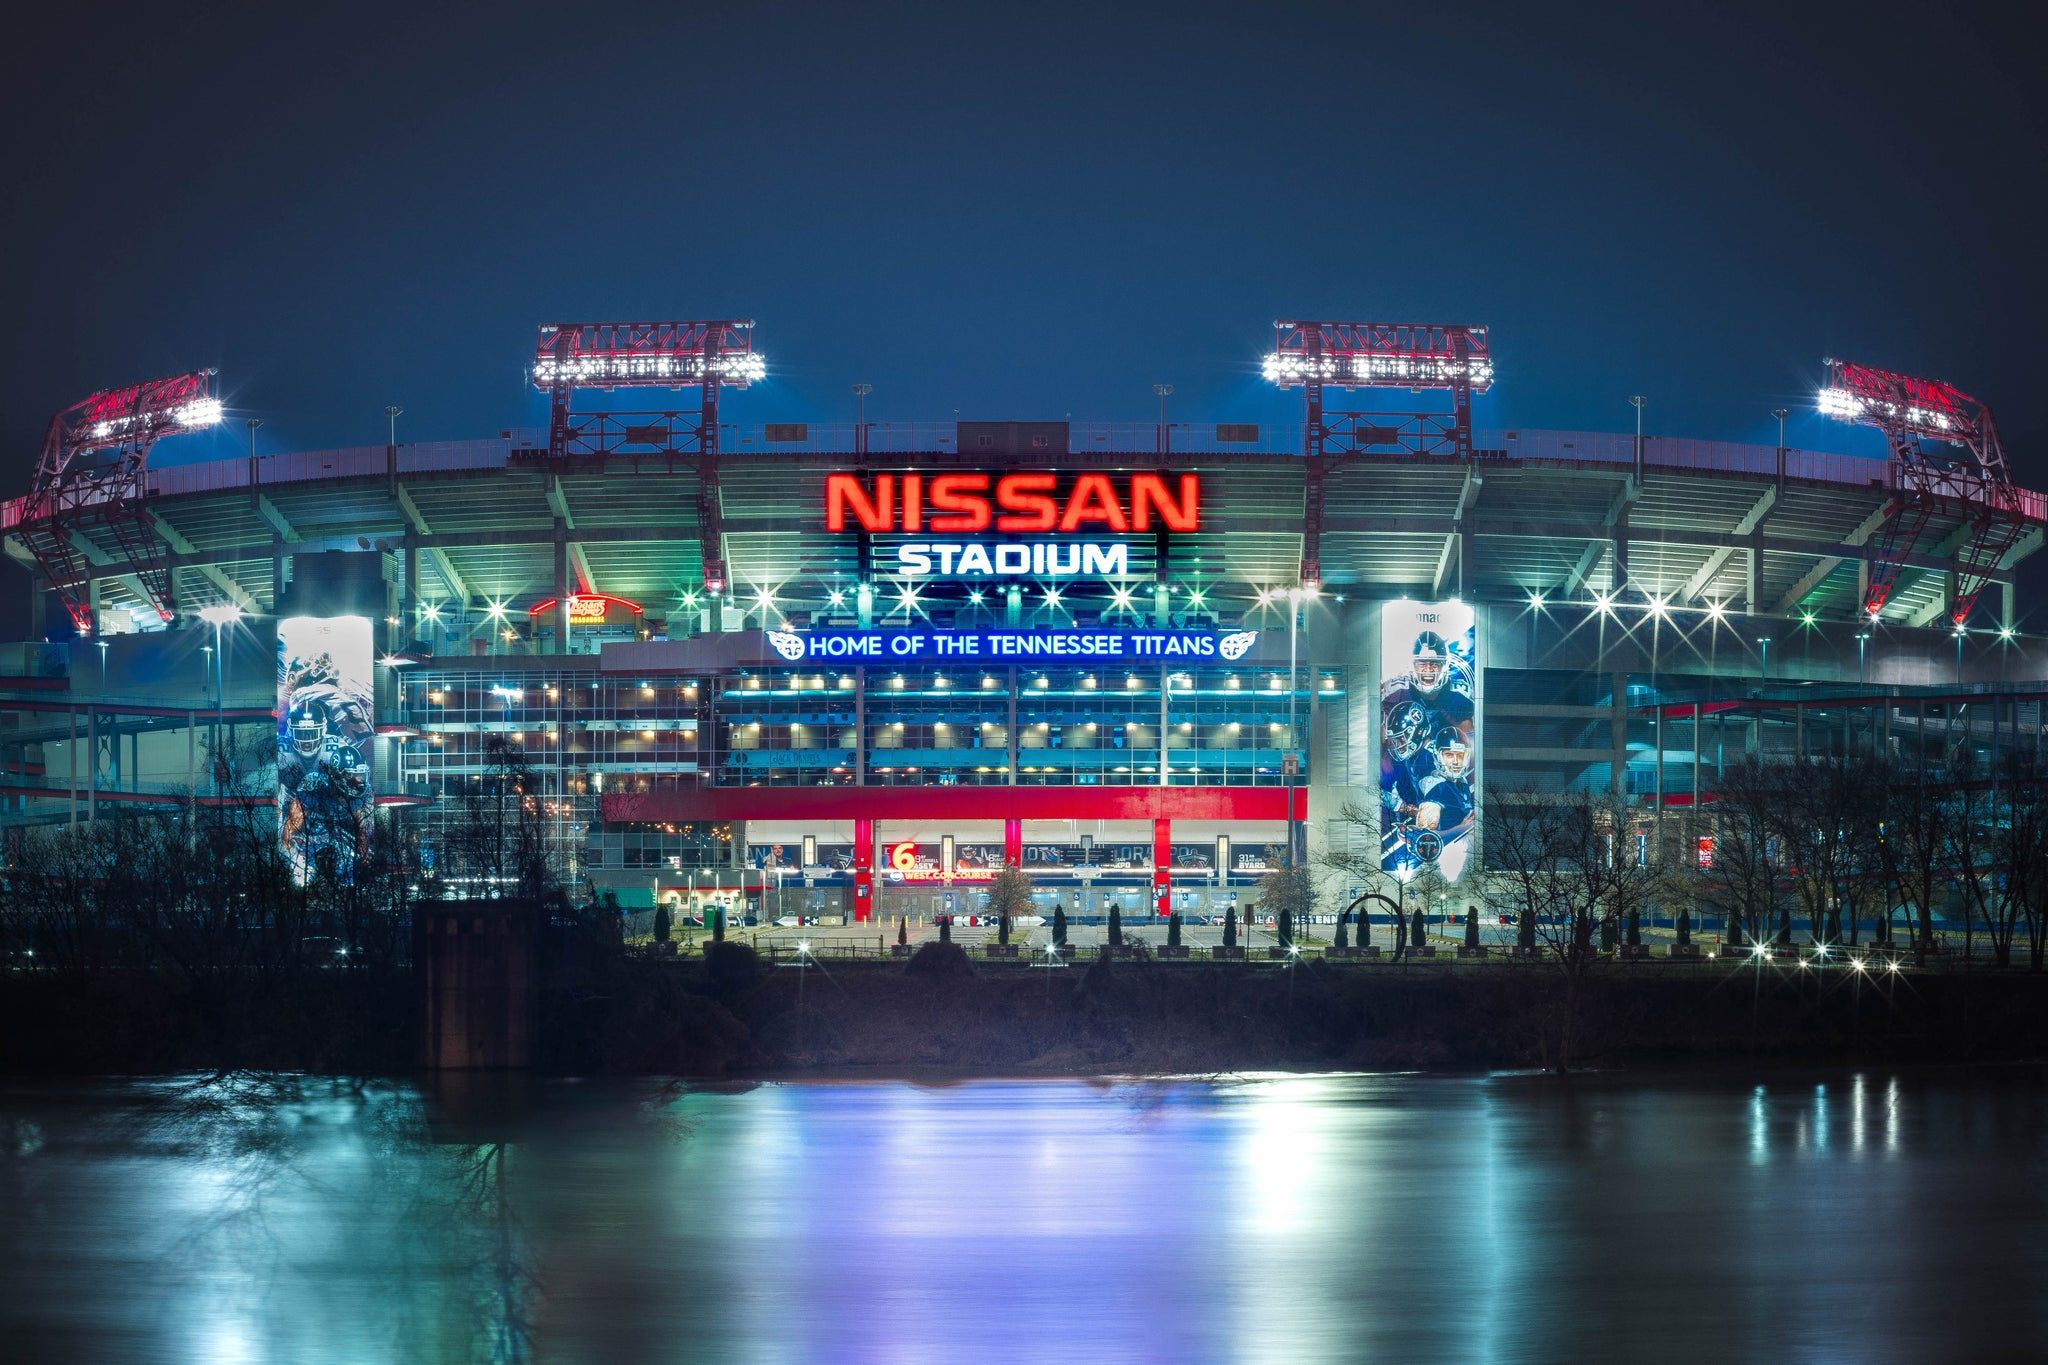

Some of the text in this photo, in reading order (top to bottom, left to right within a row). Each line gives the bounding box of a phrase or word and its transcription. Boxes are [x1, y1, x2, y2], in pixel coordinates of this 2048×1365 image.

[825, 474, 1200, 532] NISSAN
[898, 543, 1128, 575] STADIUM
[809, 635, 1215, 656] HOME OF THE TENNESSEE TITANS
[1284, 761, 1297, 775] H
[892, 842, 916, 871] 6
[1238, 853, 1249, 862] 31
[904, 872, 993, 880] WEST CONCOURSE
